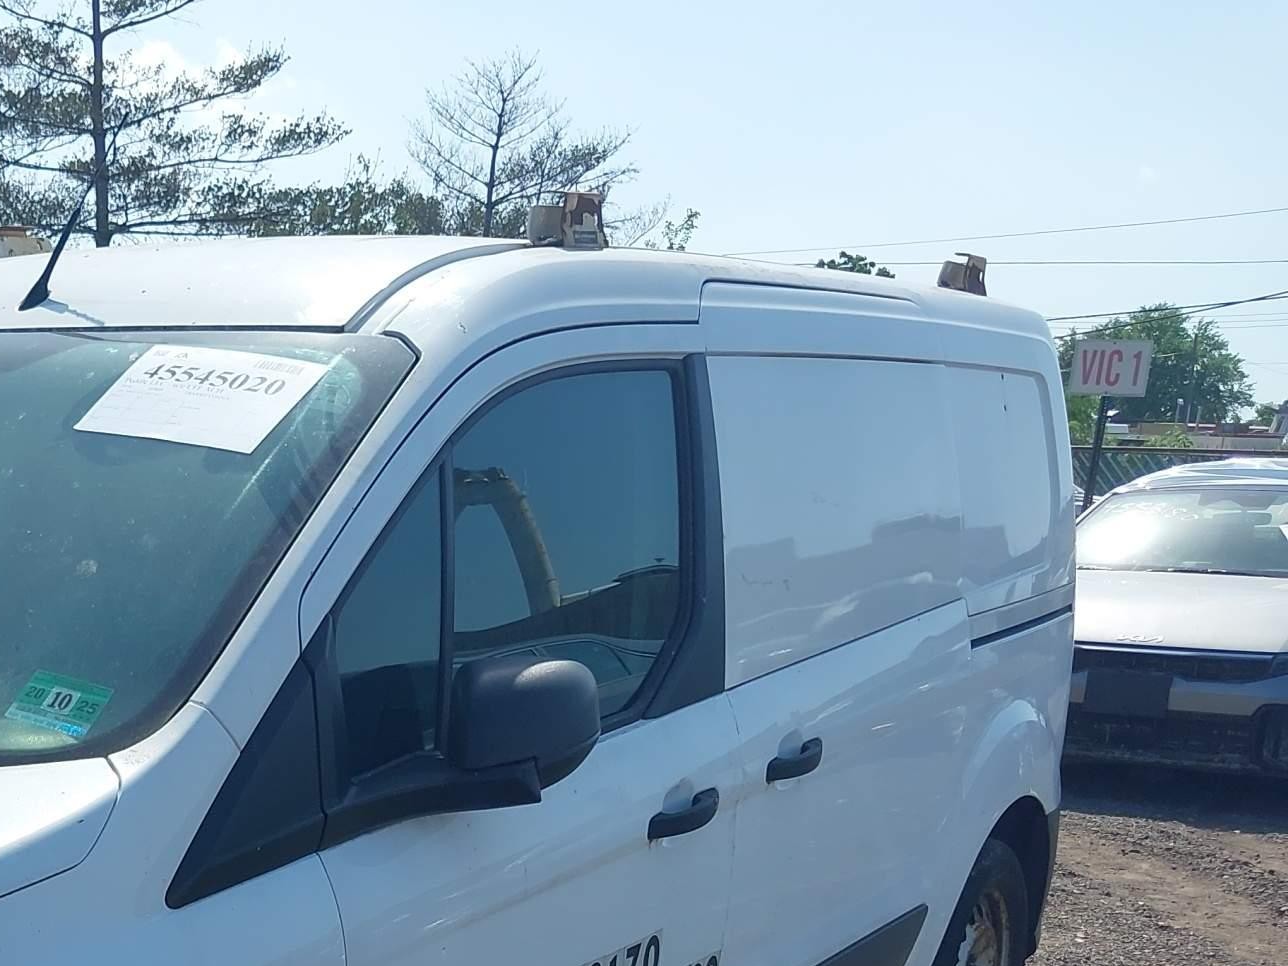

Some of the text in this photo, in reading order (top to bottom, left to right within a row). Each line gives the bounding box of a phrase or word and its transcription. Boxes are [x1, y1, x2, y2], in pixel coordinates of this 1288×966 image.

[143, 363, 287, 397] 45545020
[1080, 348, 1143, 387] VIC 1
[24, 686, 100, 714] 20 10 25
